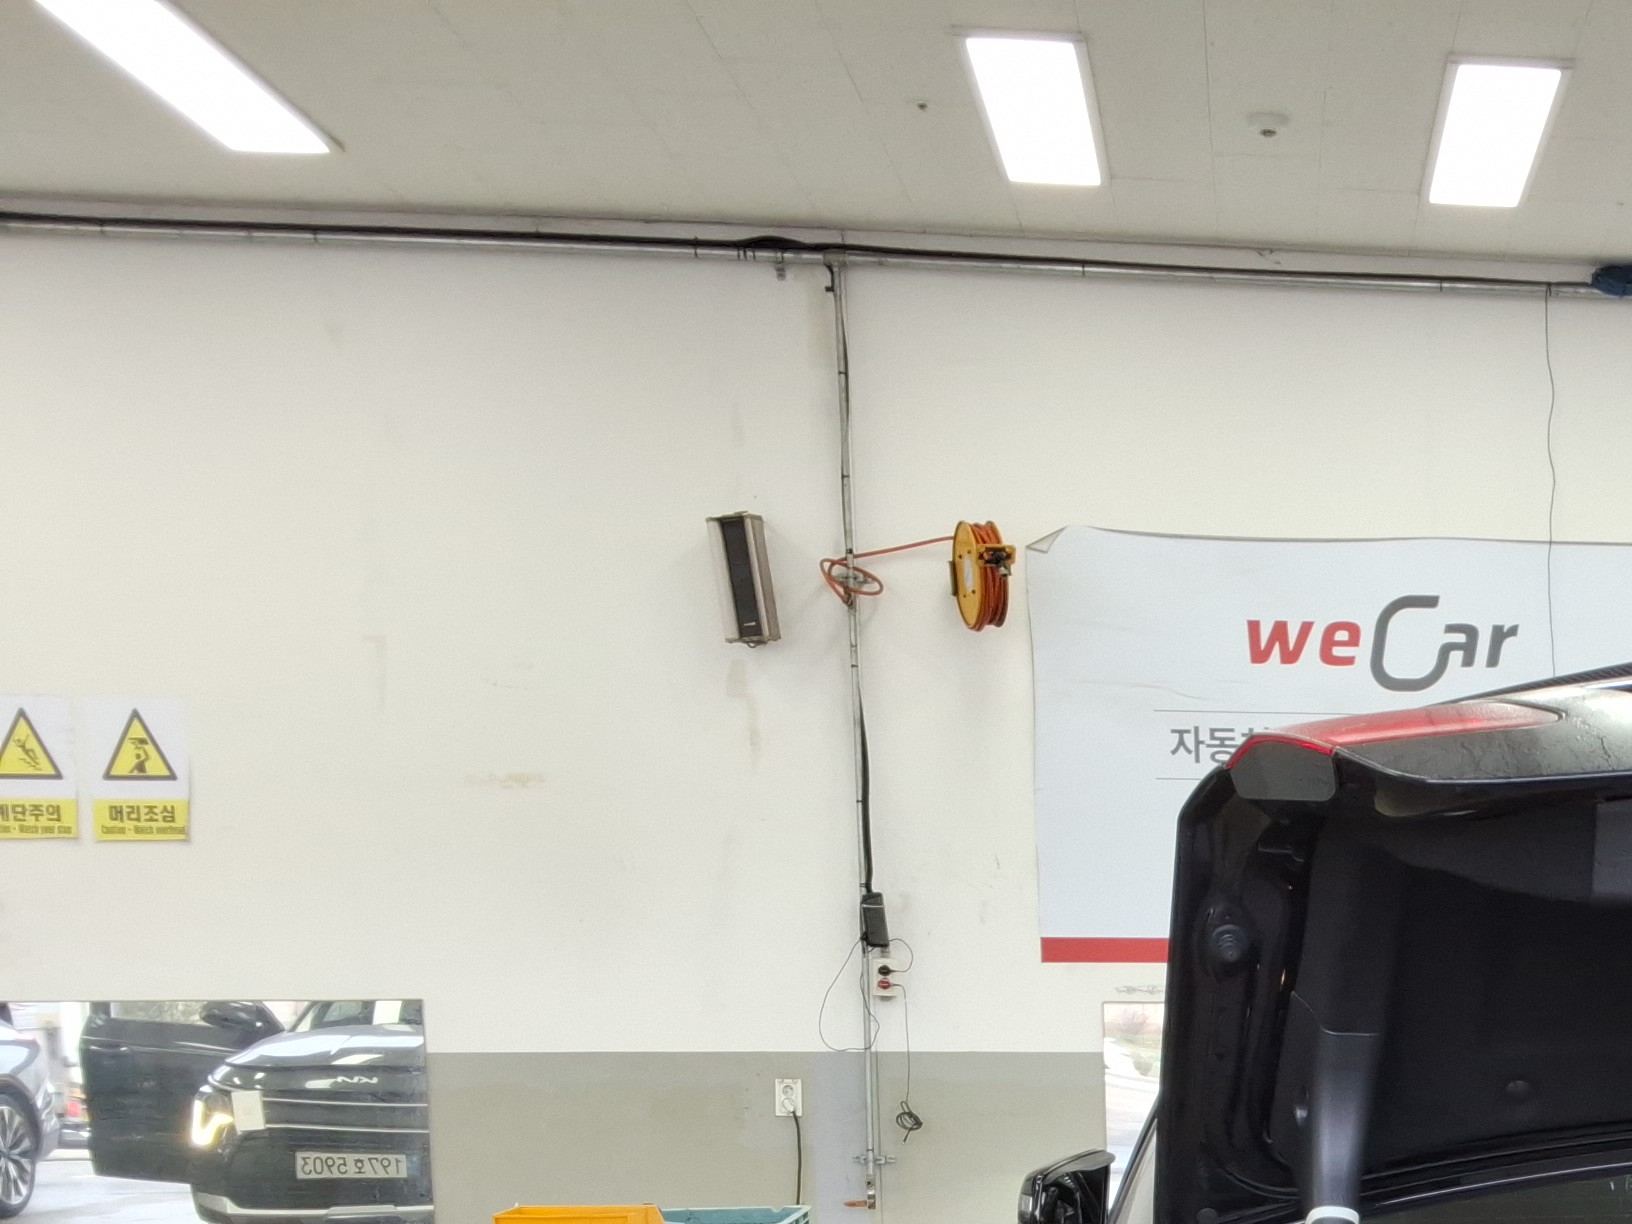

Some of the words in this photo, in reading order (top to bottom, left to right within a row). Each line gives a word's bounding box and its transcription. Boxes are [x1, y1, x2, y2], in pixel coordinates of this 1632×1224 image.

[1246, 595, 1520, 692] weCar
[1170, 725, 1269, 764] 자동
[108, 805, 176, 823] 머리조심
